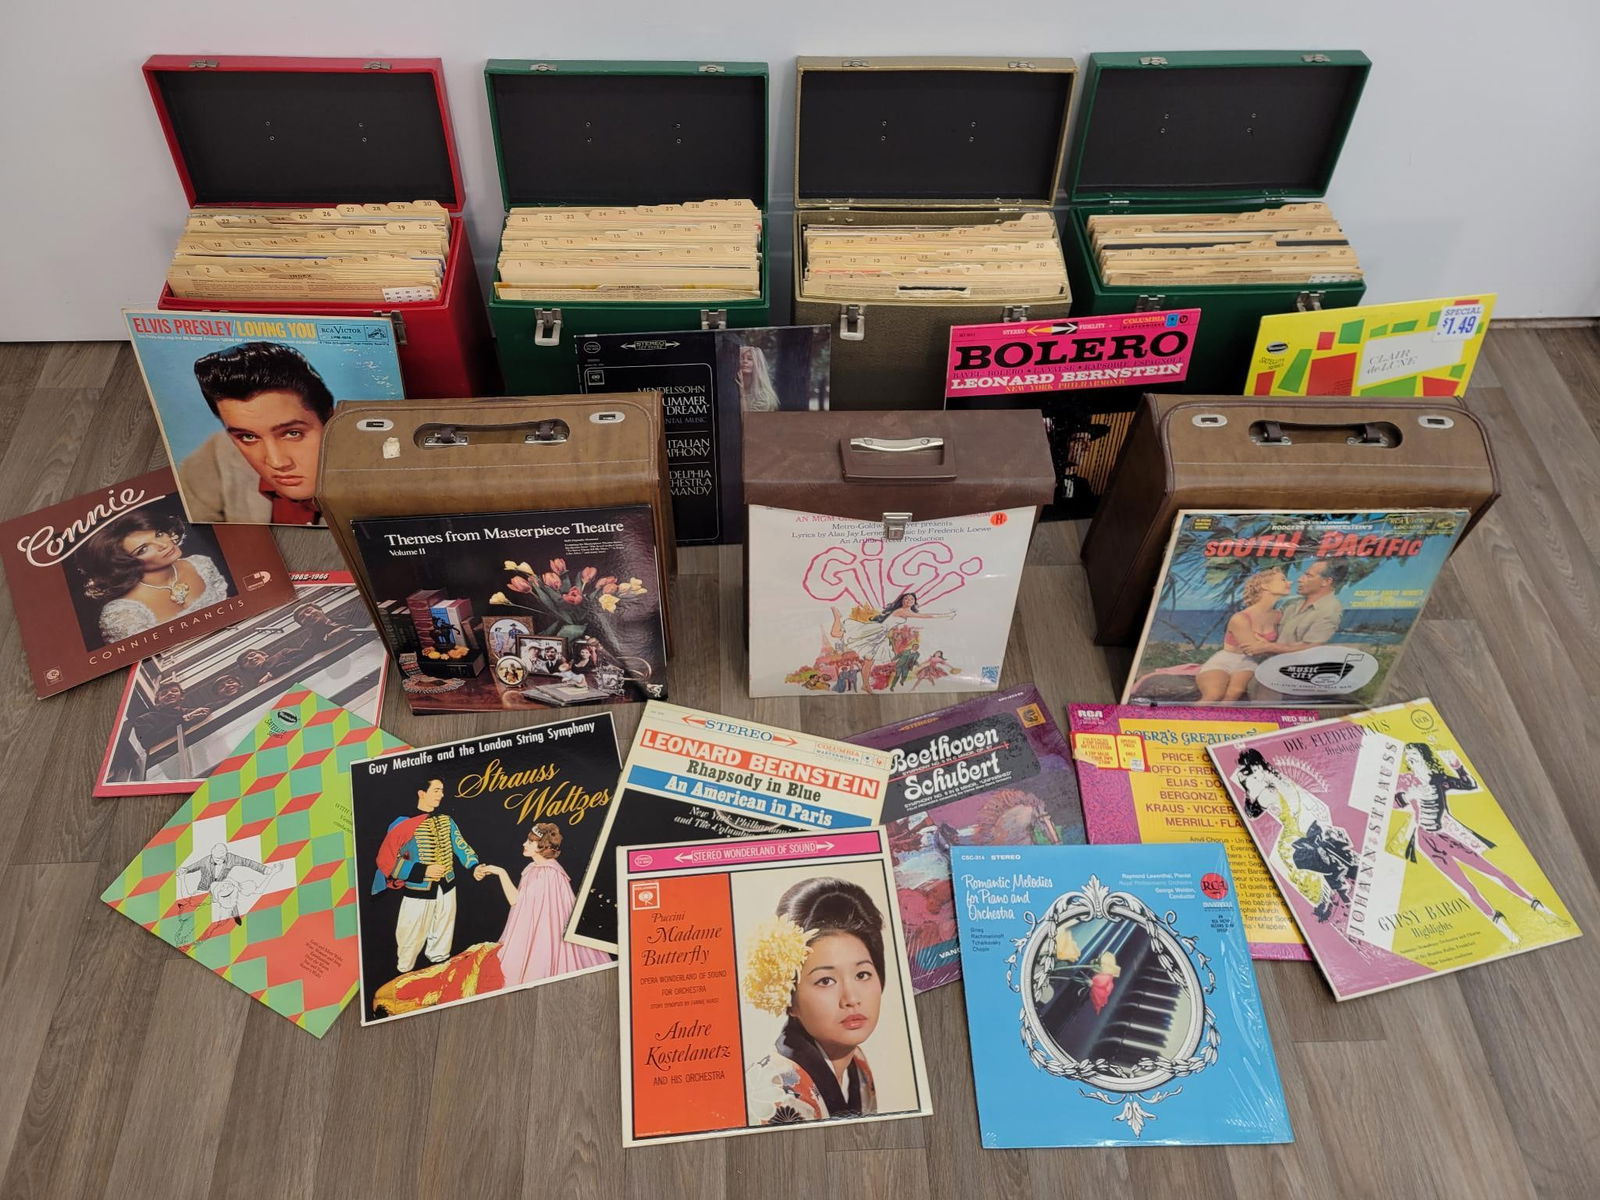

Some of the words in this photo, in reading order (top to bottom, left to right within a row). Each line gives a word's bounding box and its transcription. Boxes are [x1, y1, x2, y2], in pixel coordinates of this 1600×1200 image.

[1444, 305, 1482, 316] SPECIAL
[132, 317, 172, 334] ELVIS
[287, 322, 317, 340] YOU
[1122, 315, 1166, 325] COLUMBIA
[1442, 315, 1478, 335] $1.49
[953, 330, 1189, 371] BOLERO
[1369, 349, 1411, 366] CLAIR
[951, 373, 1055, 390] LEONARD
[1061, 362, 1184, 382] BERNSTEIN
[1005, 384, 1025, 393] NEW
[1030, 383, 1054, 391] YORK
[661, 395, 708, 407] UMMER
[17, 487, 150, 567] Connie
[919, 520, 953, 528] presents
[384, 532, 443, 547] Themes
[445, 530, 482, 543] from
[484, 524, 571, 541] Masterpiece
[571, 522, 624, 536] Theatre
[792, 531, 816, 539] Lyrics
[846, 530, 860, 538] Jay
[904, 535, 945, 543] Production
[389, 548, 418, 556] Volume
[1203, 530, 1304, 558] SOUTH
[1315, 530, 1424, 558] PACIFIC
[89, 632, 160, 665] CONNIE
[168, 599, 246, 636] FRANCIS
[1287, 666, 1320, 674] MUSIC
[1291, 672, 1315, 680] CITY
[1077, 709, 1104, 718] RCA
[705, 719, 773, 743] STEREO
[904, 717, 935, 731] STEREO
[1283, 734, 1306, 753] DIE
[1312, 719, 1393, 748] FLEDERMAUS
[368, 762, 388, 776] Guy
[392, 754, 433, 771] Metcalfe
[437, 749, 455, 762] and
[459, 744, 475, 757] the
[478, 737, 513, 754] London
[516, 731, 545, 748] String
[547, 721, 596, 740] Symphony
[817, 743, 860, 757] COLUMBIA
[890, 728, 999, 775] Beethoven
[1162, 752, 1194, 761] PRICE
[644, 730, 742, 766] LEONARD
[749, 756, 881, 799] BERNSTEIN
[454, 758, 560, 799] Strauss
[686, 760, 763, 792] Rhapsody
[766, 775, 782, 793] in
[787, 783, 822, 803] Blue
[904, 751, 1001, 801] Schubert
[1166, 778, 1198, 788] ELIAS
[503, 780, 613, 826] Waltzes
[665, 775, 688, 793] An
[690, 780, 767, 812] American
[770, 798, 786, 815] in
[788, 804, 833, 827] Paris
[904, 797, 933, 809] SYMPHONY
[1160, 791, 1218, 801] BERGONZI
[689, 805, 710, 818] New
[1146, 803, 1185, 813] KRAUS
[674, 815, 692, 826] and
[694, 818, 711, 830] The
[1166, 817, 1217, 827] MERRILL
[1350, 849, 1377, 937] JOHANN
[1369, 741, 1398, 835] STRAUSS
[692, 849, 722, 862] STEREO
[723, 845, 776, 859] WONDERLAND
[777, 844, 788, 855] OF
[789, 841, 816, 854] SOUND
[960, 874, 1010, 890] Romantic
[1012, 873, 1054, 892] Melodies
[1202, 880, 1229, 891] RCA
[966, 890, 979, 908] for
[977, 888, 1009, 904] Piano
[1010, 890, 1031, 904] and
[652, 911, 686, 924] Puccini
[968, 904, 1015, 921] Orchestra
[1378, 909, 1422, 932] GYPSY
[1424, 897, 1472, 920] BARON
[647, 925, 722, 944] Madame
[1411, 921, 1454, 940] Highlights
[641, 945, 710, 967] Butterfly
[640, 976, 659, 985] OPERA
[659, 972, 698, 983] WONDERLAND
[698, 971, 706, 979] OF
[707, 969, 727, 979] SOUND
[661, 988, 673, 997] FOR
[674, 985, 707, 995] ORCHESTRA
[655, 1019, 712, 1041] Andre
[644, 1044, 731, 1072] Kostelanetz
[653, 1076, 669, 1086] AND
[670, 1074, 683, 1084] HIS
[685, 1070, 726, 1083] ORCHESTRA
